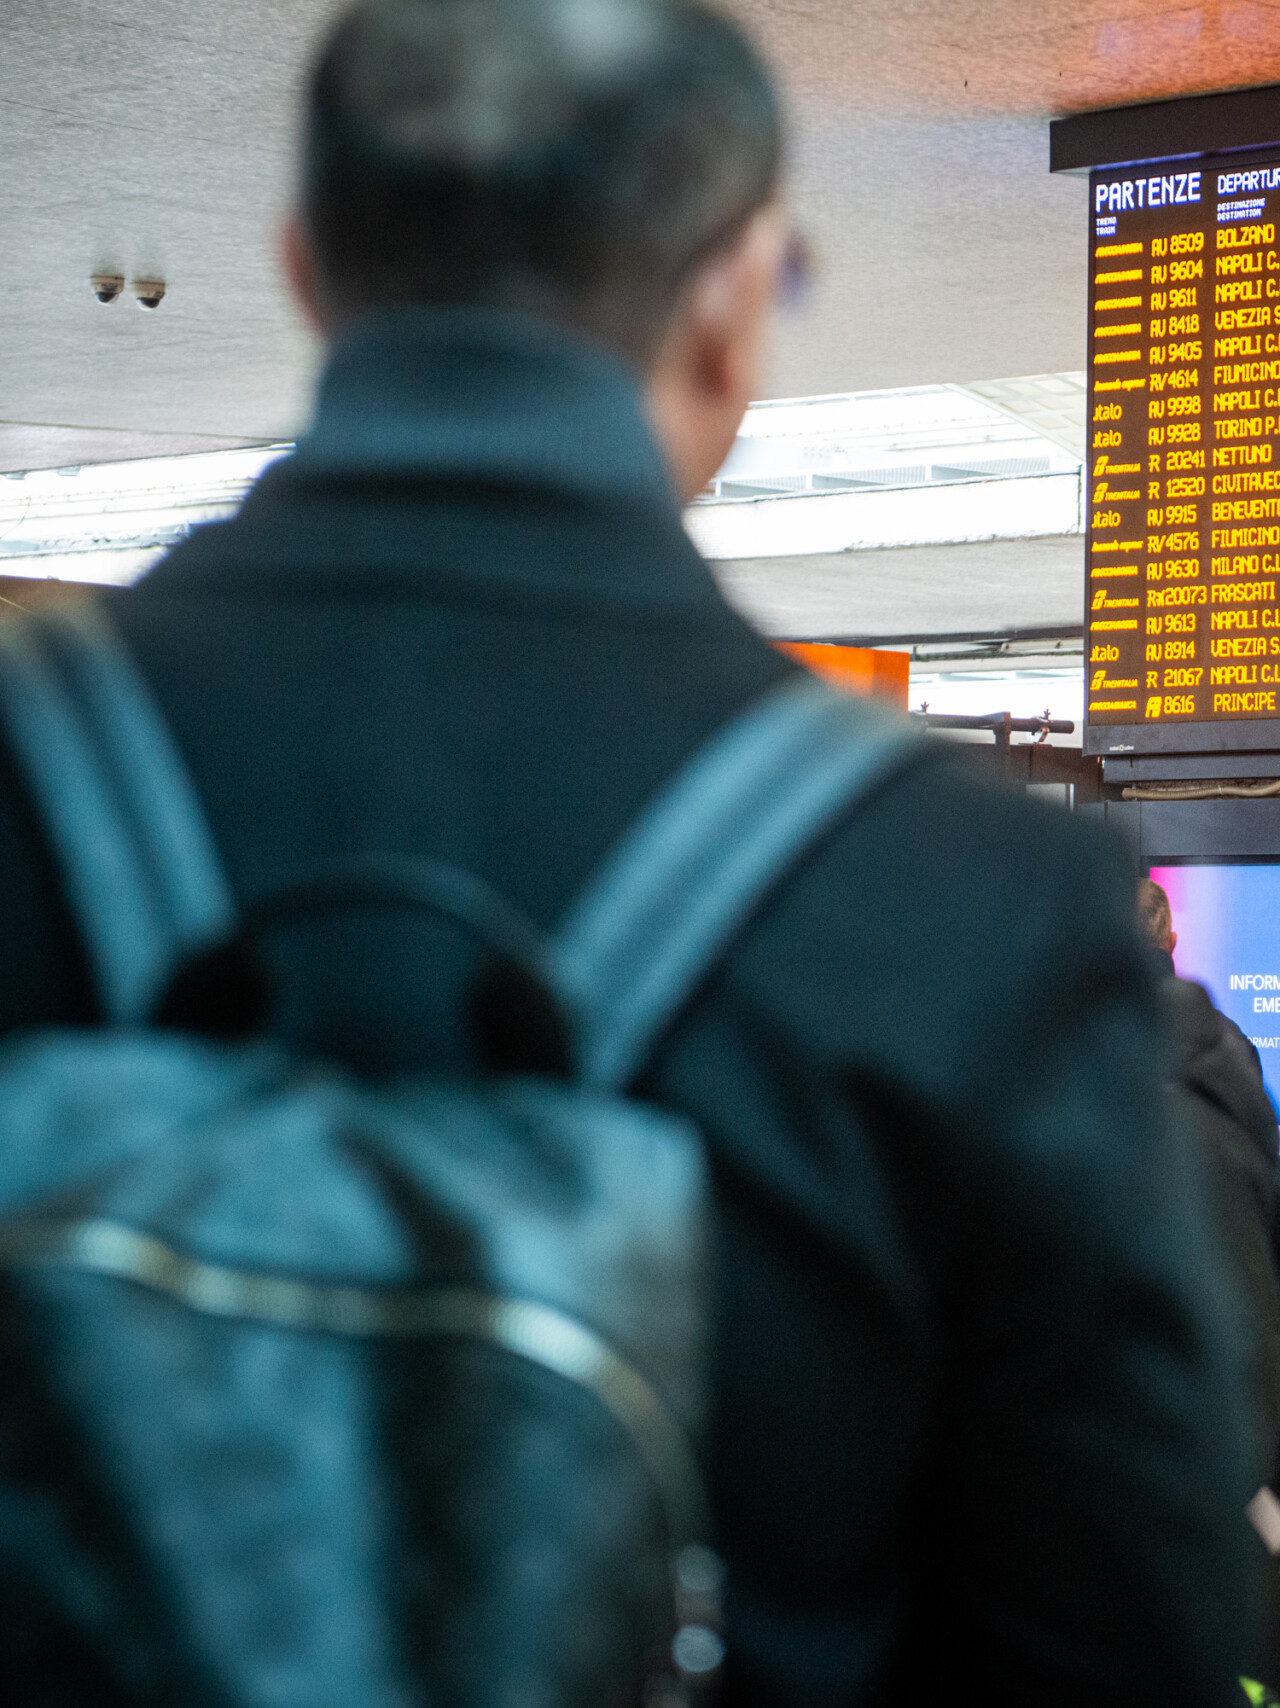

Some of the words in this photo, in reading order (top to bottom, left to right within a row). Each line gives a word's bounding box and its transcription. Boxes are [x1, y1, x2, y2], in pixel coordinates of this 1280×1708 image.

[1096, 172, 1202, 213] PARTENZE
[1217, 198, 1266, 213] DESTINAZIONE
[1096, 216, 1117, 227] TRENO
[1217, 208, 1262, 223] DESTINATION
[1096, 226, 1116, 237] TRAIN
[1151, 237, 1168, 258] AV
[1169, 231, 1205, 255] 8509
[1216, 223, 1275, 250] BOLZANO
[1150, 264, 1168, 285] AV
[1169, 259, 1204, 282] 9604
[1215, 251, 1264, 276] NAPOLI
[1150, 291, 1168, 312] AV
[1168, 287, 1197, 309] 9611
[1214, 279, 1263, 304] NAPOLI
[1149, 318, 1167, 339] AV
[1168, 313, 1200, 336] 8418
[1214, 306, 1271, 331] VENEZIA
[1149, 345, 1167, 366] AV
[1167, 340, 1203, 363] 9405
[1213, 334, 1262, 358] NAPOLI
[1148, 399, 1166, 419] AV
[1166, 394, 1202, 417] 9998
[1213, 389, 1262, 413] NAPOLI
[1147, 426, 1165, 446] AV
[1166, 422, 1202, 444] 9928
[1213, 416, 1263, 440] TORINO
[1165, 449, 1206, 471] 20241
[1212, 443, 1273, 468] NETTUNO
[1165, 476, 1206, 498] 12520
[1146, 508, 1164, 527] AV
[1165, 503, 1198, 526] 9915
[1211, 525, 1280, 549] FIUMICINO
[1146, 562, 1164, 581] AV
[1164, 558, 1200, 580] 9630
[1210, 554, 1260, 577] MILANO
[1210, 580, 1276, 604] FRASCATI
[1145, 616, 1163, 636] AV
[1164, 612, 1197, 634] 9613
[1210, 609, 1259, 631] NAPOLI
[1145, 643, 1163, 662] AV
[1163, 640, 1196, 661] 8914
[1210, 636, 1268, 658] VENEZIA
[1163, 667, 1204, 688] 21067
[1209, 664, 1258, 686] NAPOLI
[1162, 694, 1196, 715] 8616
[1213, 691, 1277, 713] PRINCIPE
